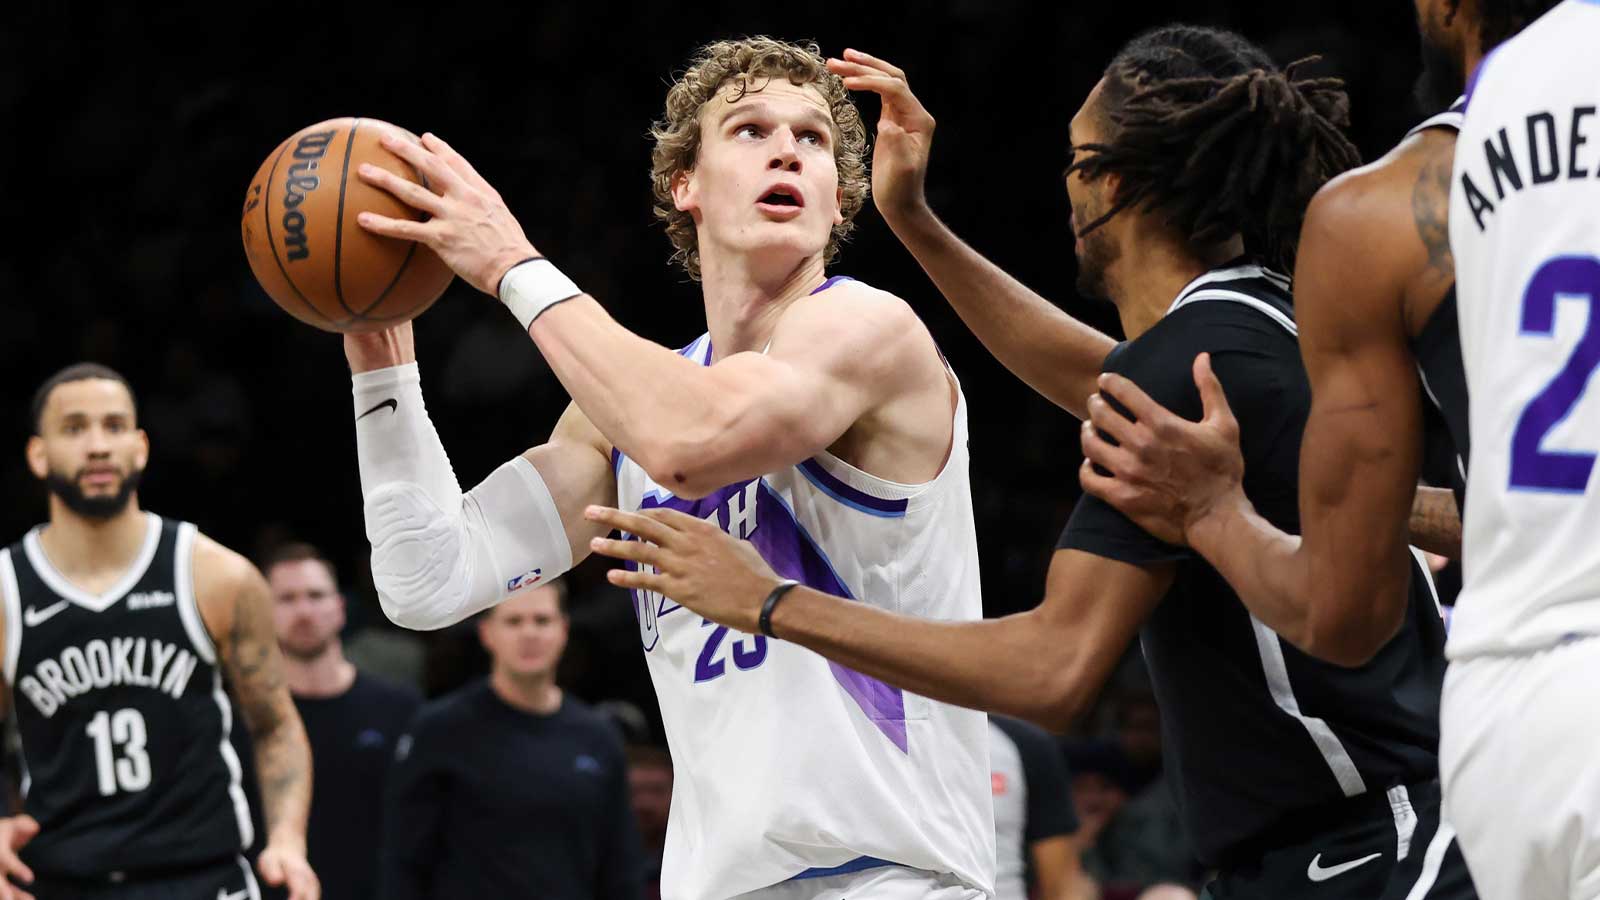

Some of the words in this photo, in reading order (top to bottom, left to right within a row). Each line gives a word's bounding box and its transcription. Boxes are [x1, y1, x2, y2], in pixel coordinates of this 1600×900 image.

[284, 129, 337, 262] Wilson
[1461, 106, 1600, 232] ANDE
[1506, 255, 1600, 495] 2
[19, 636, 198, 717] BROOKLYN
[86, 708, 152, 796] 13
